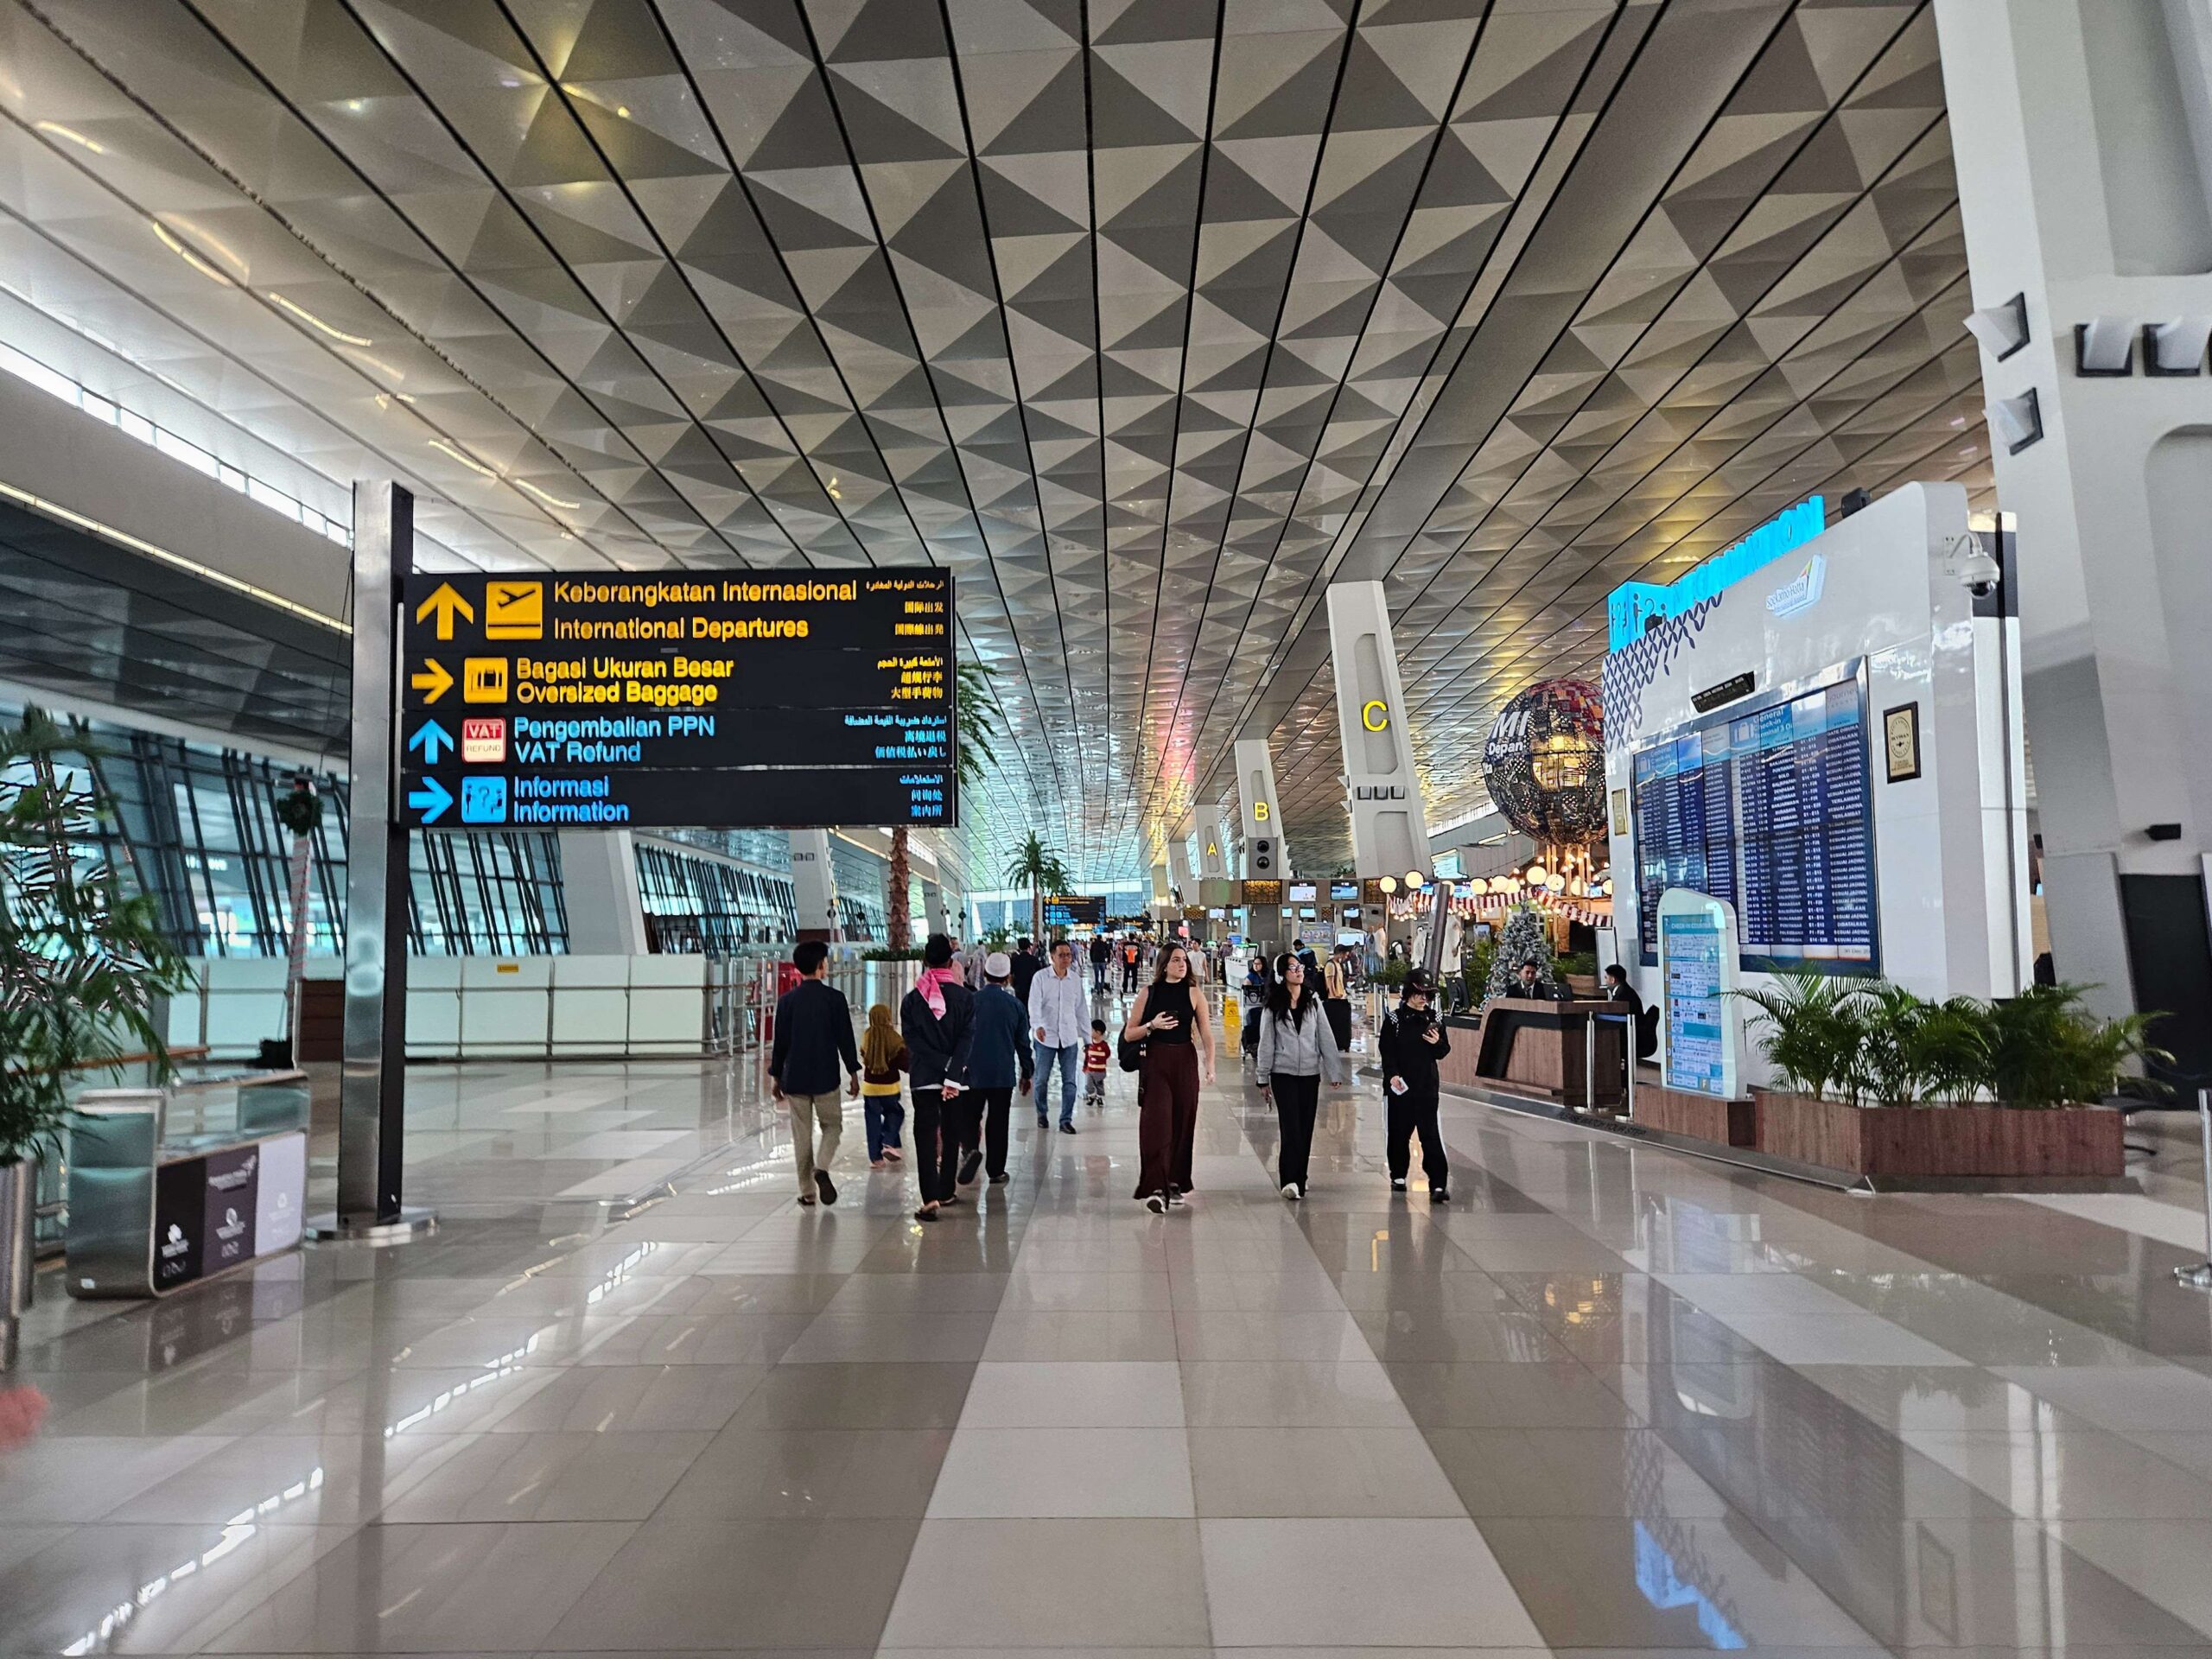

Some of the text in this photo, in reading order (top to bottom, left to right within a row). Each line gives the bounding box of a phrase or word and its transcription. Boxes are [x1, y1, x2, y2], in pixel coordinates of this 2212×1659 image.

[554, 579, 857, 607] Keberangkatan Internasional
[554, 616, 809, 643] International Departures
[517, 656, 734, 683] Bagasi Ukuran Besar
[517, 680, 718, 707] Oversized Baggage
[891, 686, 944, 700] 大型手荷物
[1363, 700, 1388, 732] C
[467, 723, 501, 739] VAT
[514, 715, 715, 741] Pengembalian PPN
[466, 744, 501, 753] REFUND
[515, 741, 642, 763] VAT Refund
[1489, 742, 1523, 757] Depan
[514, 775, 609, 798] Informasi
[514, 800, 629, 823] Information
[1254, 801, 1269, 821] B
[1207, 842, 1217, 856] A
